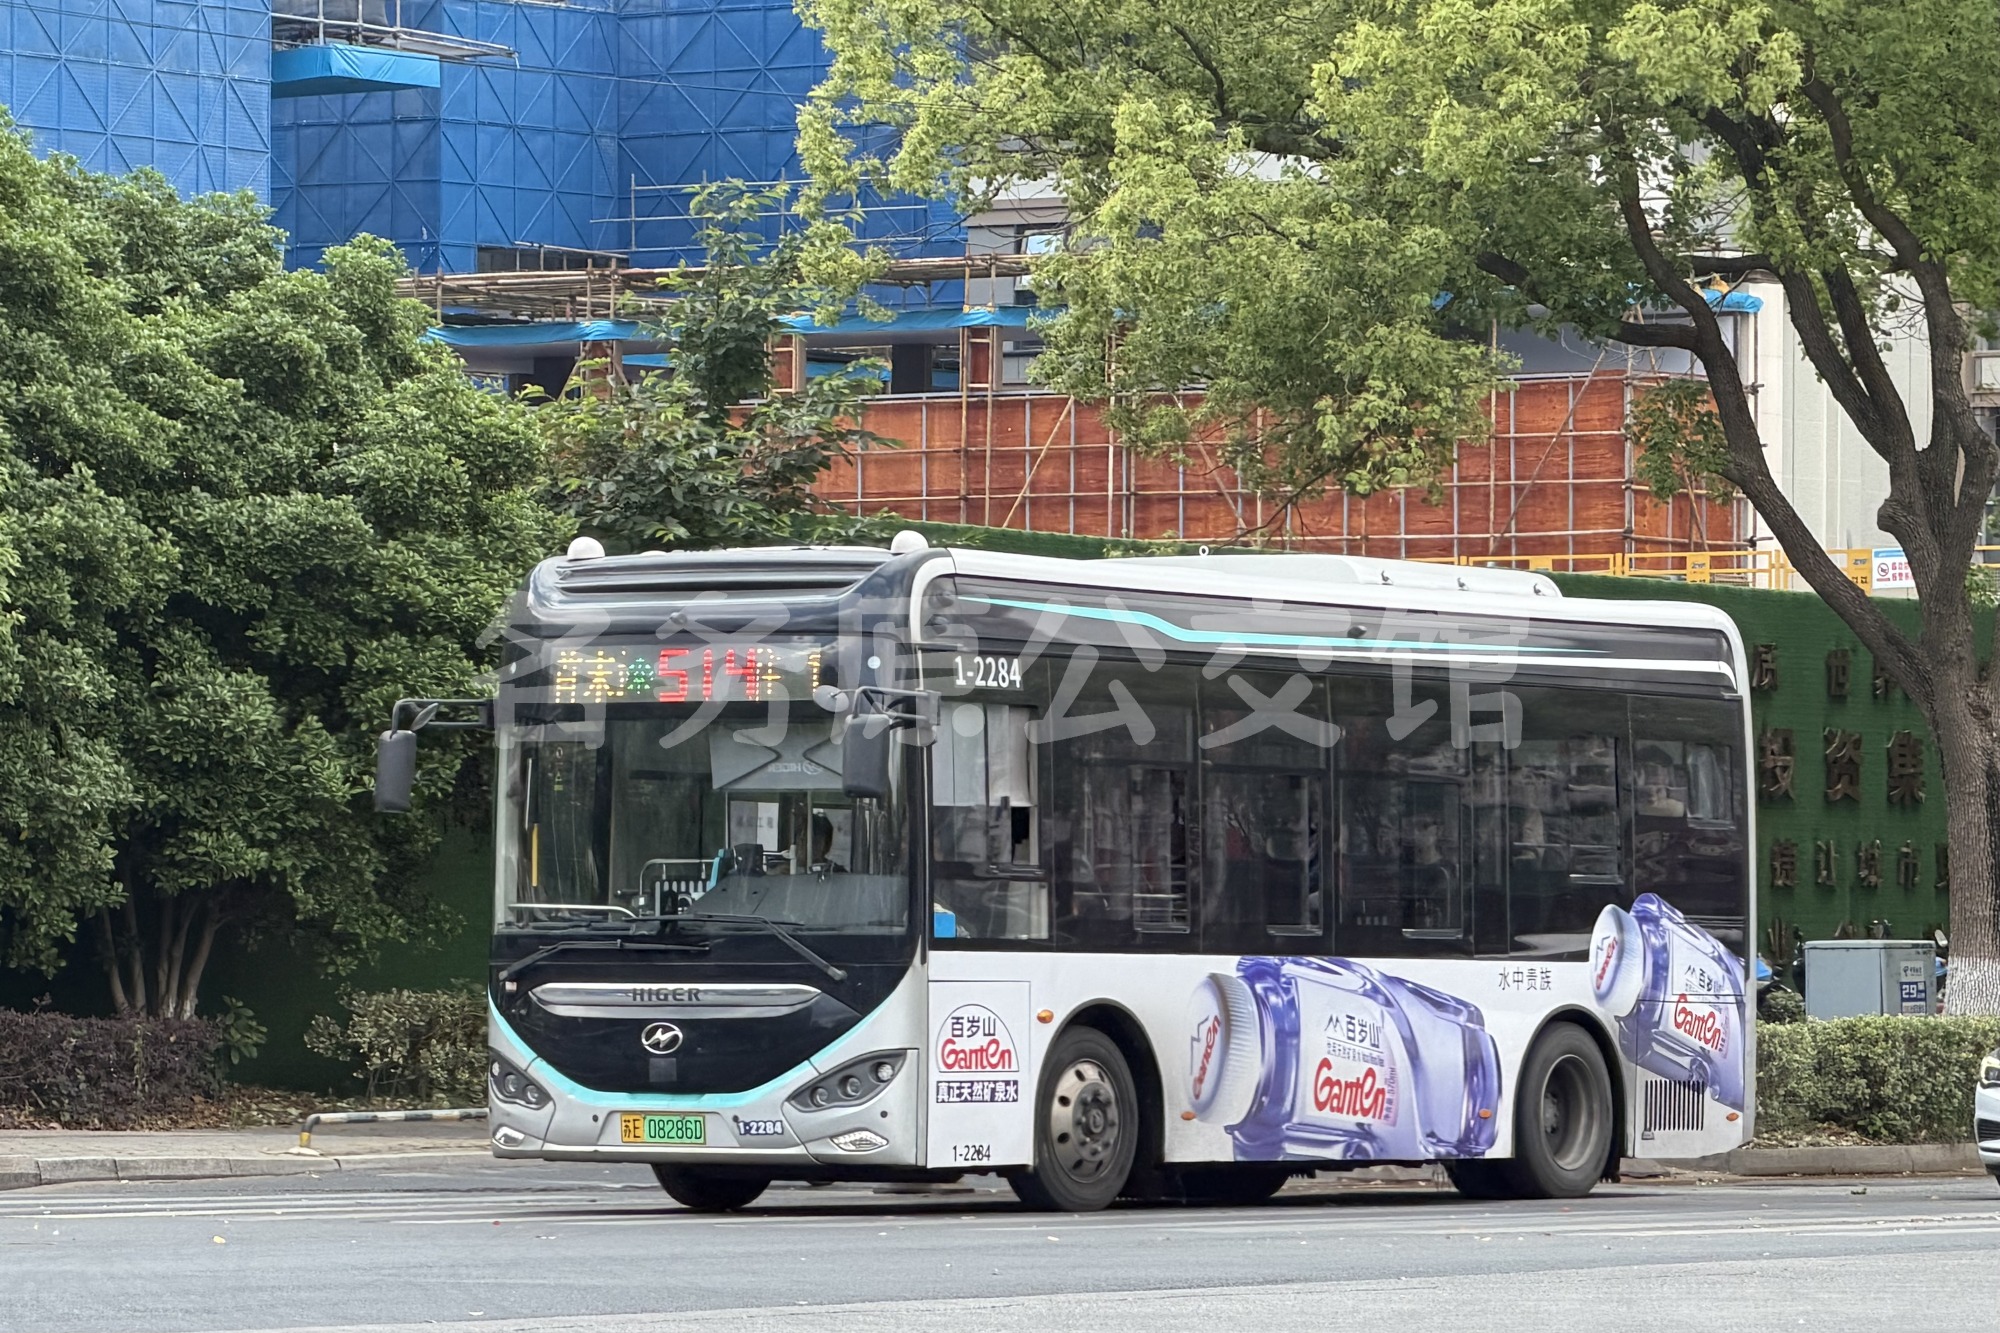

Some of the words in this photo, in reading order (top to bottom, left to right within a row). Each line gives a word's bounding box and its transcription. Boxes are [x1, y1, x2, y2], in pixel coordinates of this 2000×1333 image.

[659, 648, 756, 701] 514
[955, 655, 1021, 688] 1-2284
[1498, 966, 1552, 991] 水中贵族
[1902, 984, 1917, 998] 29
[632, 987, 701, 1002] HIGER
[951, 1016, 996, 1038] 百岁山
[1345, 1014, 1380, 1049] 百岁山
[1674, 993, 1721, 1051] Ganten
[941, 1038, 1012, 1070] Ganten
[936, 1081, 1018, 1102] 真正天然矿泉水
[1313, 1057, 1386, 1120] Ganten
[648, 1118, 703, 1140] 08286D
[952, 1144, 991, 1162] 1-2284
